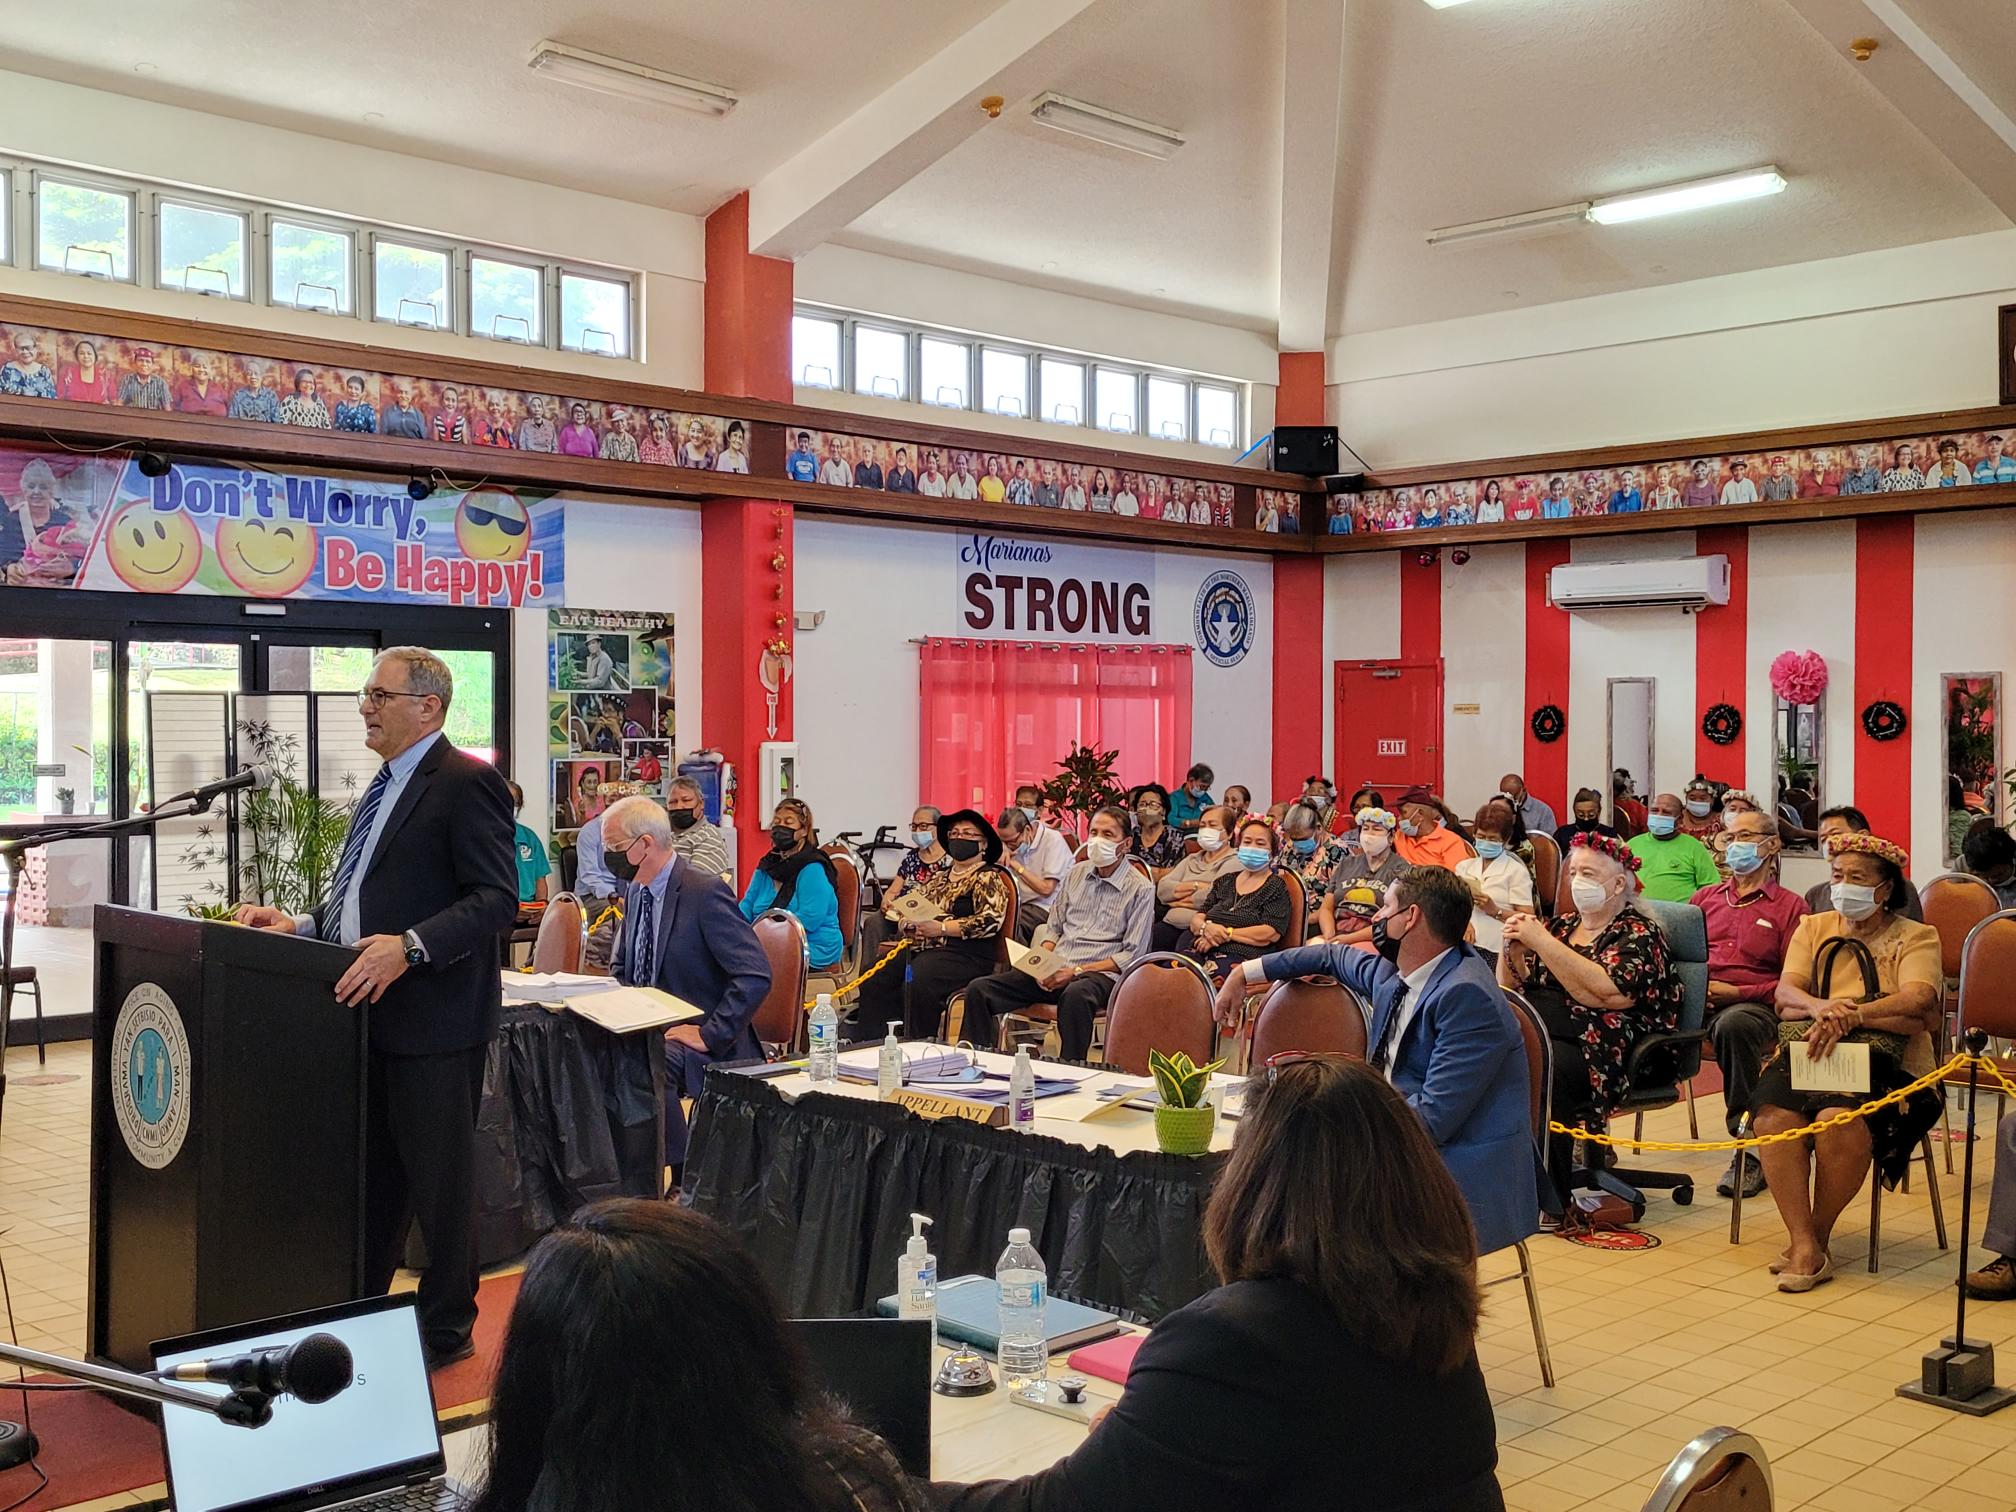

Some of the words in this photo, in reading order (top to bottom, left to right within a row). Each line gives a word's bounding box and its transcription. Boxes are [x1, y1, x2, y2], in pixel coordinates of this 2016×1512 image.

[153, 466, 273, 518] Don't
[286, 477, 427, 541] Worry,
[961, 534, 1053, 572] Marianas
[326, 538, 384, 589] Be
[396, 544, 542, 608] Happy!
[559, 615, 591, 625] EAT
[594, 616, 665, 629] HEALTHY
[964, 572, 1151, 636] STRONG
[1380, 741, 1404, 753] EXIT
[895, 1095, 987, 1120] APPELLANT
